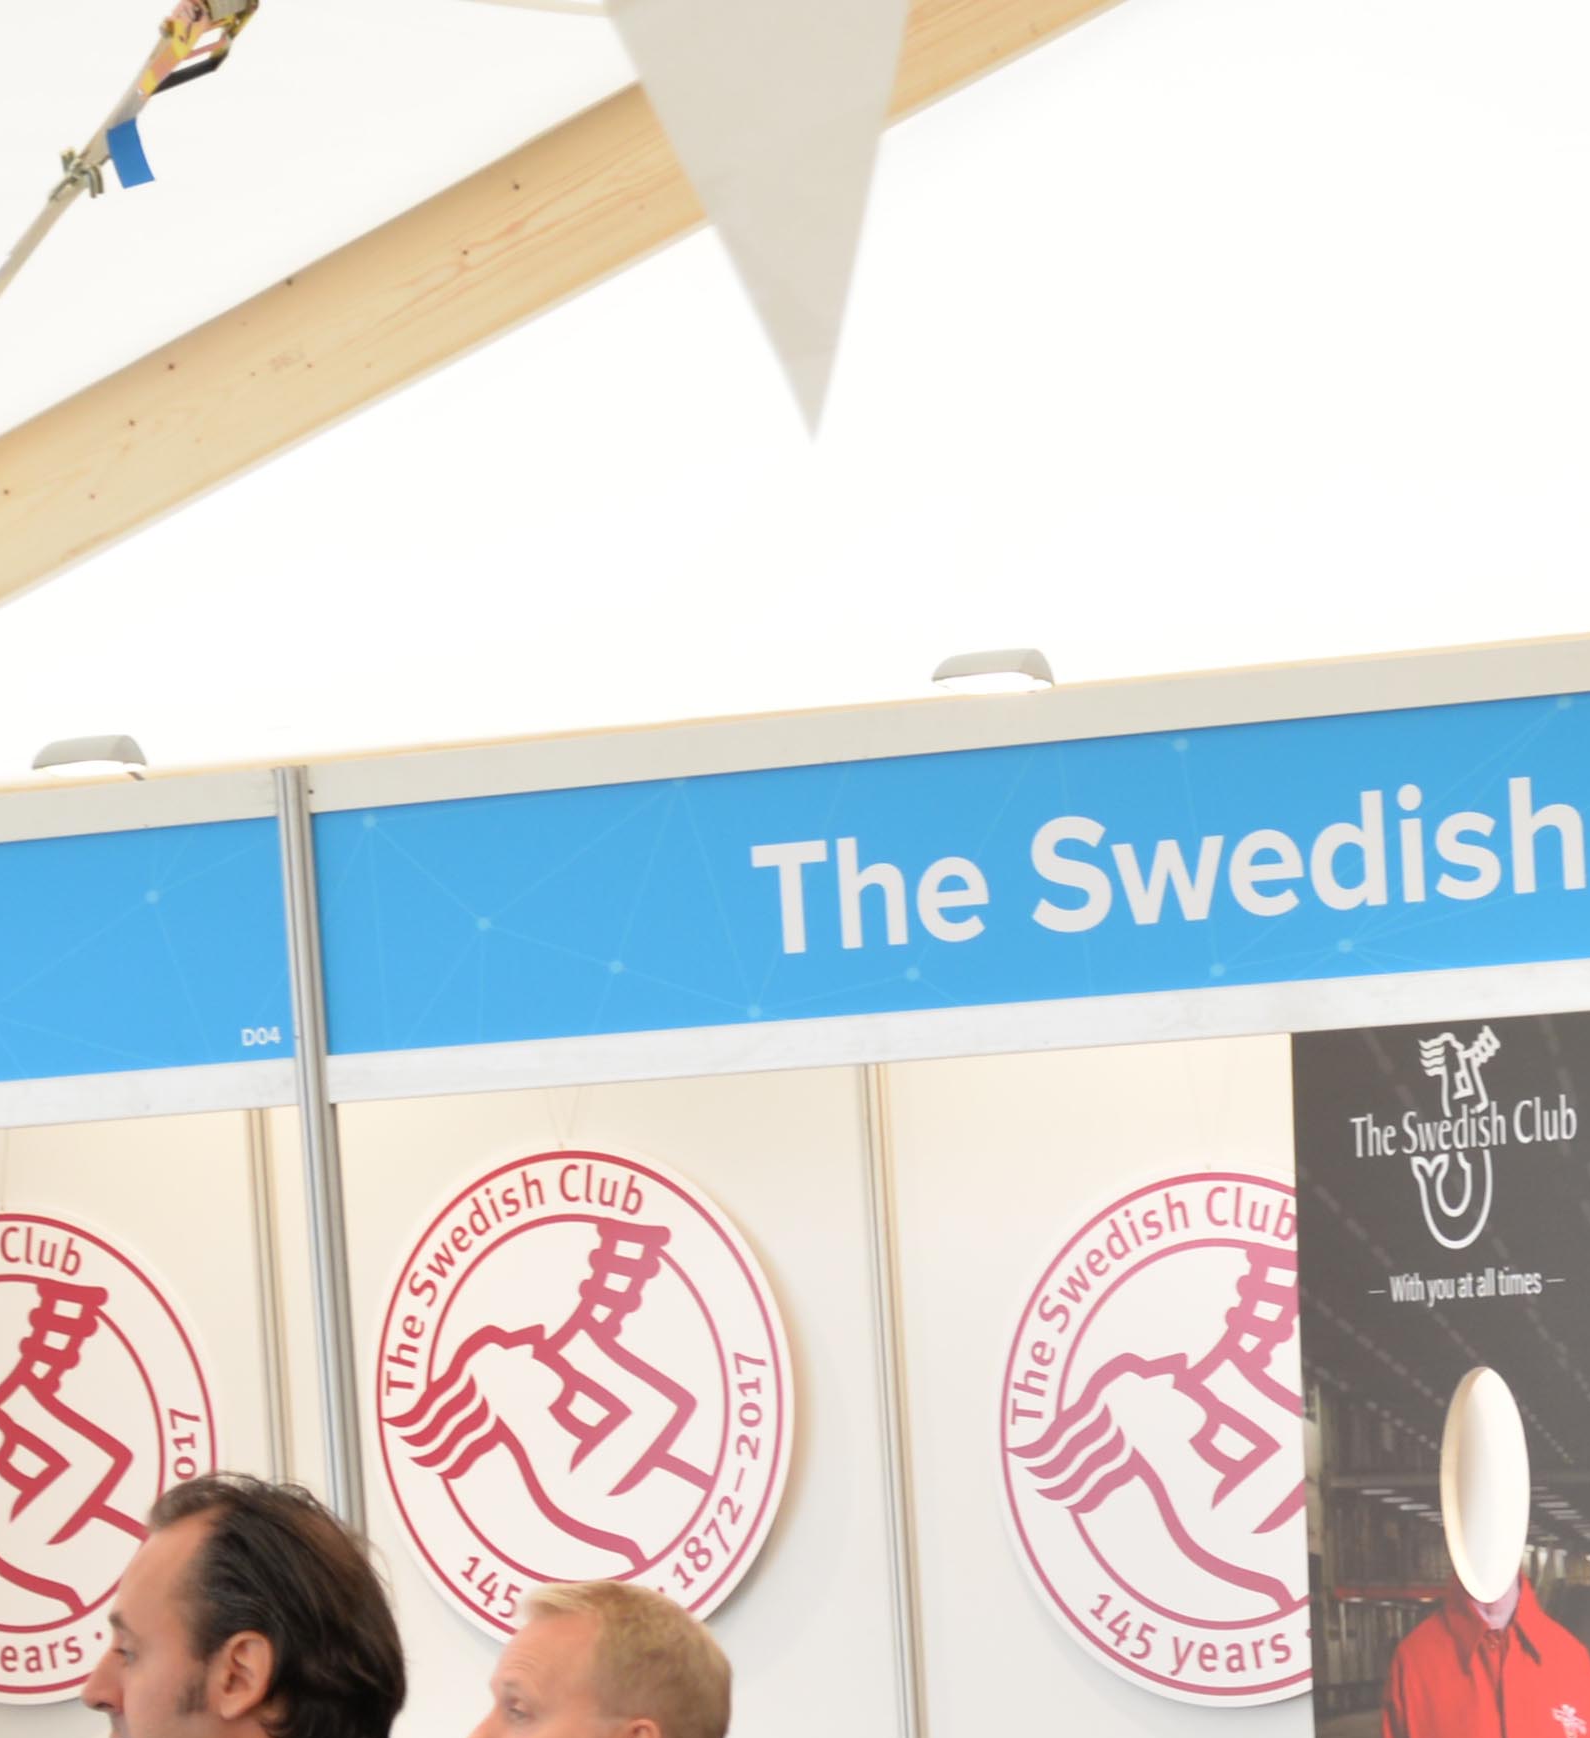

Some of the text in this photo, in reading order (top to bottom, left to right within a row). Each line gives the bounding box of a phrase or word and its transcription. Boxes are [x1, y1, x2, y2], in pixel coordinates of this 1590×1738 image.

[751, 837, 989, 954] The
[1031, 777, 1586, 933] Swedish
[241, 1026, 282, 1046] D04
[1350, 1094, 1577, 1158] The Swedish Club
[0, 1226, 83, 1277] Club
[385, 1163, 645, 1397] The Swedish Club
[1011, 1186, 1297, 1425] The Swedish Club
[1390, 1267, 1542, 1307] With you at all times
[459, 1555, 521, 1619] 145
[1088, 1593, 1293, 1677] 145 years
